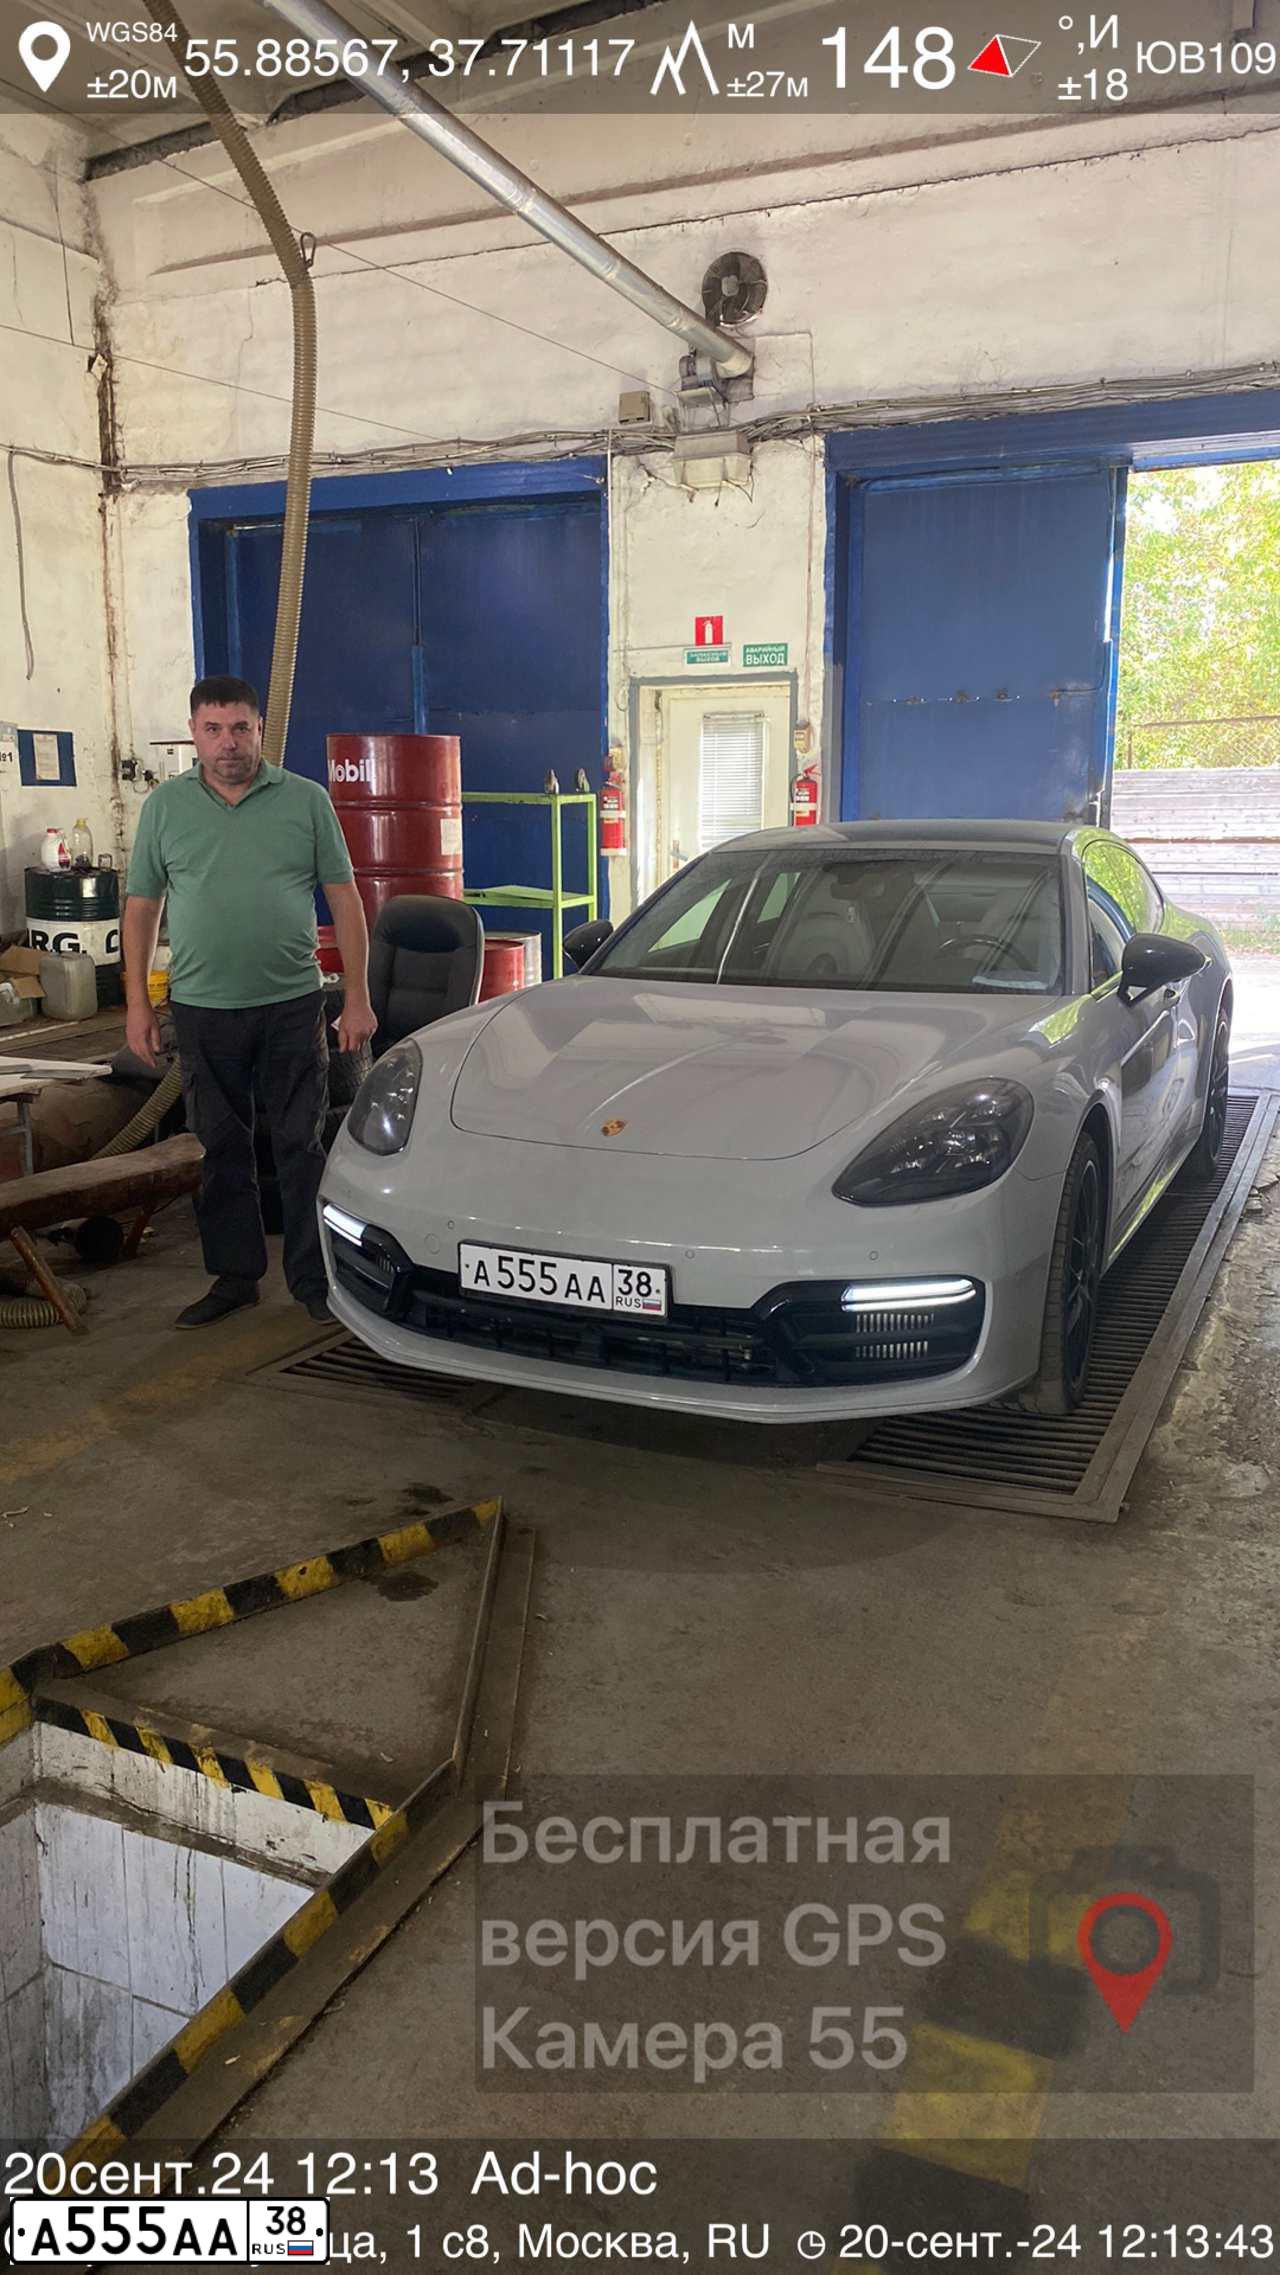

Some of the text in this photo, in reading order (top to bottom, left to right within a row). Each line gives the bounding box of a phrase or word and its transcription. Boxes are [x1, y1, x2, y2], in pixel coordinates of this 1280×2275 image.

[746, 653, 785, 665] ВЫХОД
[473, 1255, 652, 1304] А555АА 38
[615, 1295, 641, 1309] RUS
